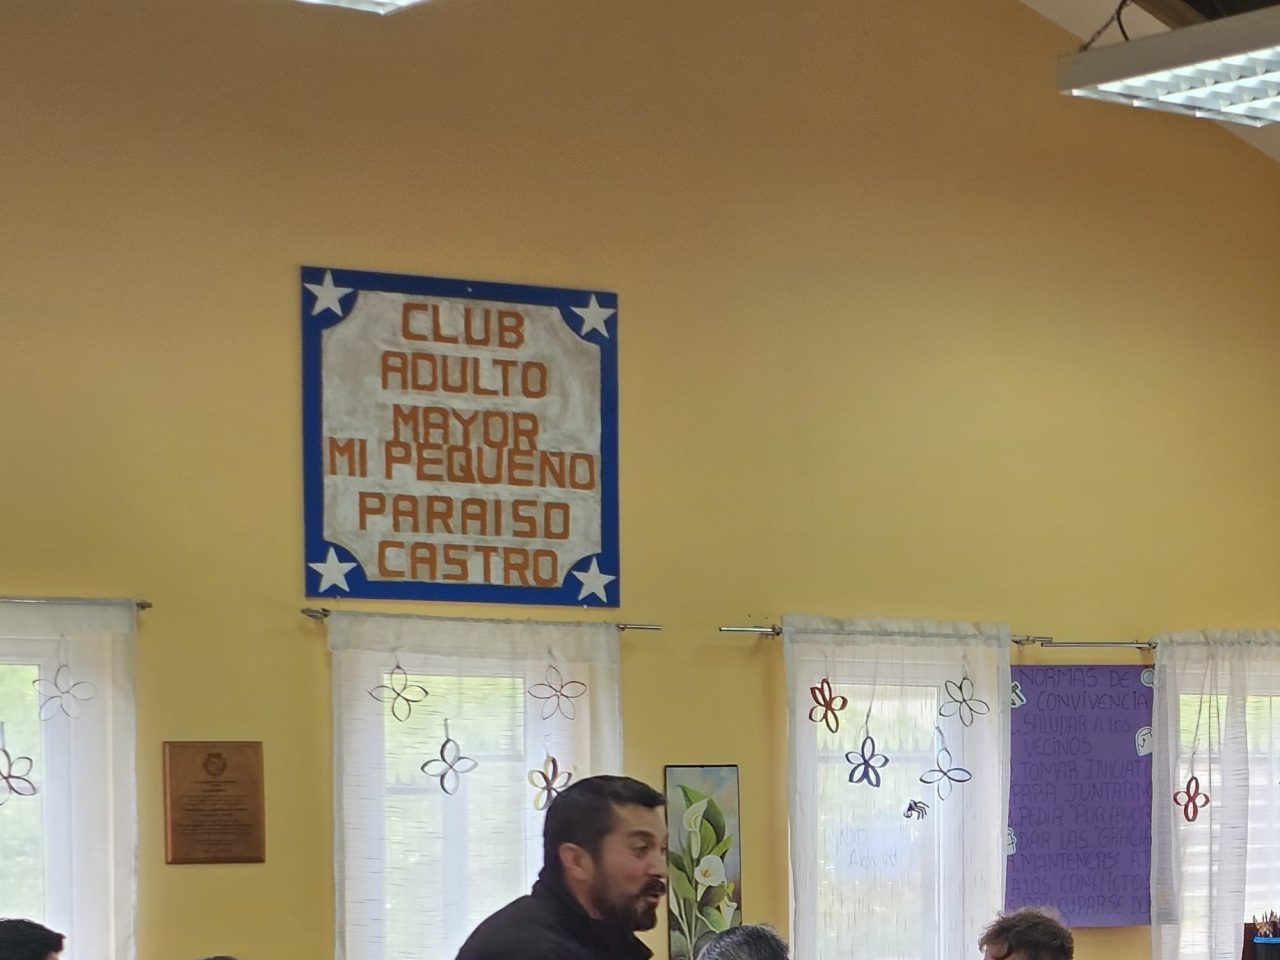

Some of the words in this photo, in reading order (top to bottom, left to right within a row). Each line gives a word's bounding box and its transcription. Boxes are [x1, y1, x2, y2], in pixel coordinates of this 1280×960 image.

[401, 302, 526, 350] CLUB
[381, 351, 548, 399] ADULTO
[392, 404, 539, 450] MAYOR
[328, 436, 368, 479] MI
[384, 441, 596, 491] PEQUENO
[358, 491, 571, 540] PARAISO
[378, 540, 559, 588] CASTRO
[1019, 667, 1098, 688] NORMAS
[1110, 670, 1131, 688] DE
[1086, 758, 1150, 780] INICIATI
